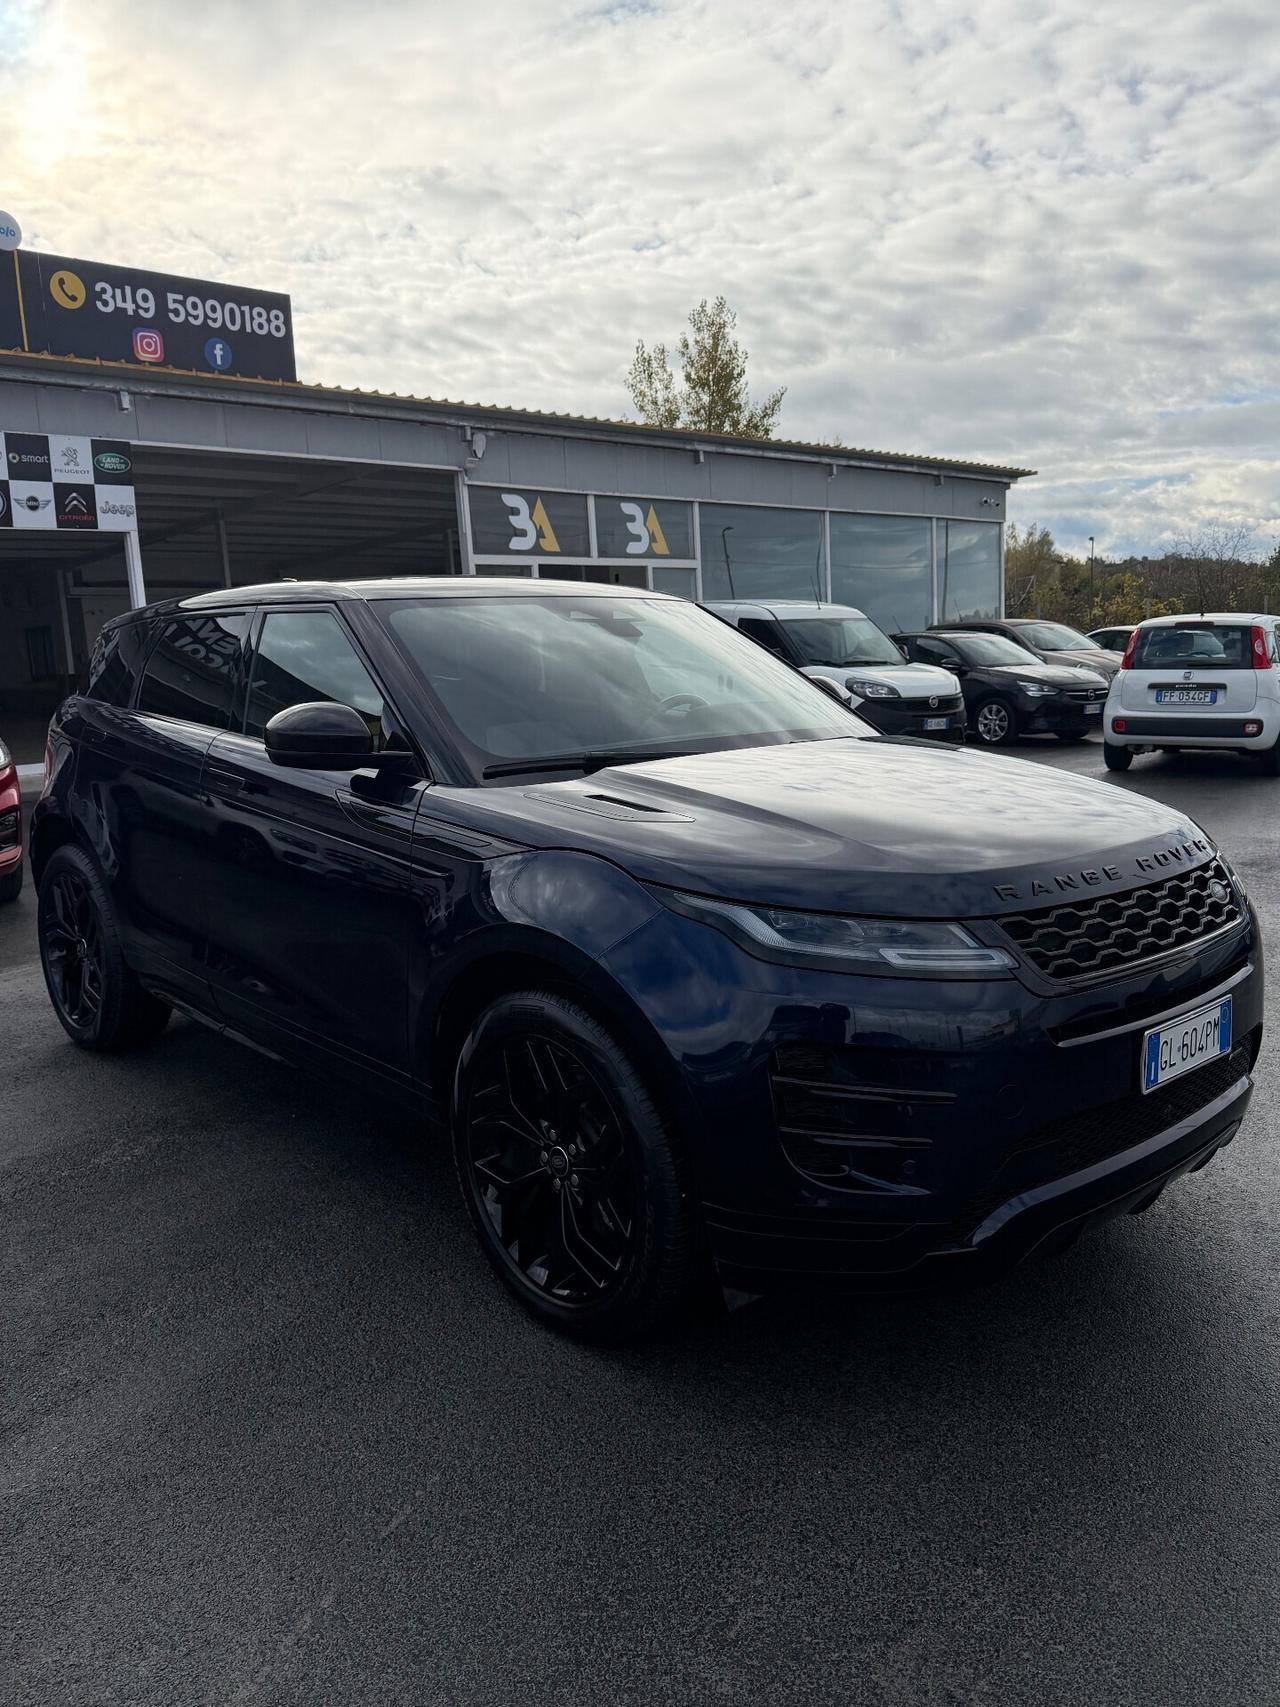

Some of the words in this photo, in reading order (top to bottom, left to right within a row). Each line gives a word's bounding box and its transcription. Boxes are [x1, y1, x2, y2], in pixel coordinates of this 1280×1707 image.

[94, 281, 156, 319] 349
[166, 292, 287, 338] 5990188
[21, 454, 49, 464] smart
[100, 501, 135, 517] Jeep
[993, 864, 1123, 901] RANGE
[1135, 839, 1209, 873] ROVER
